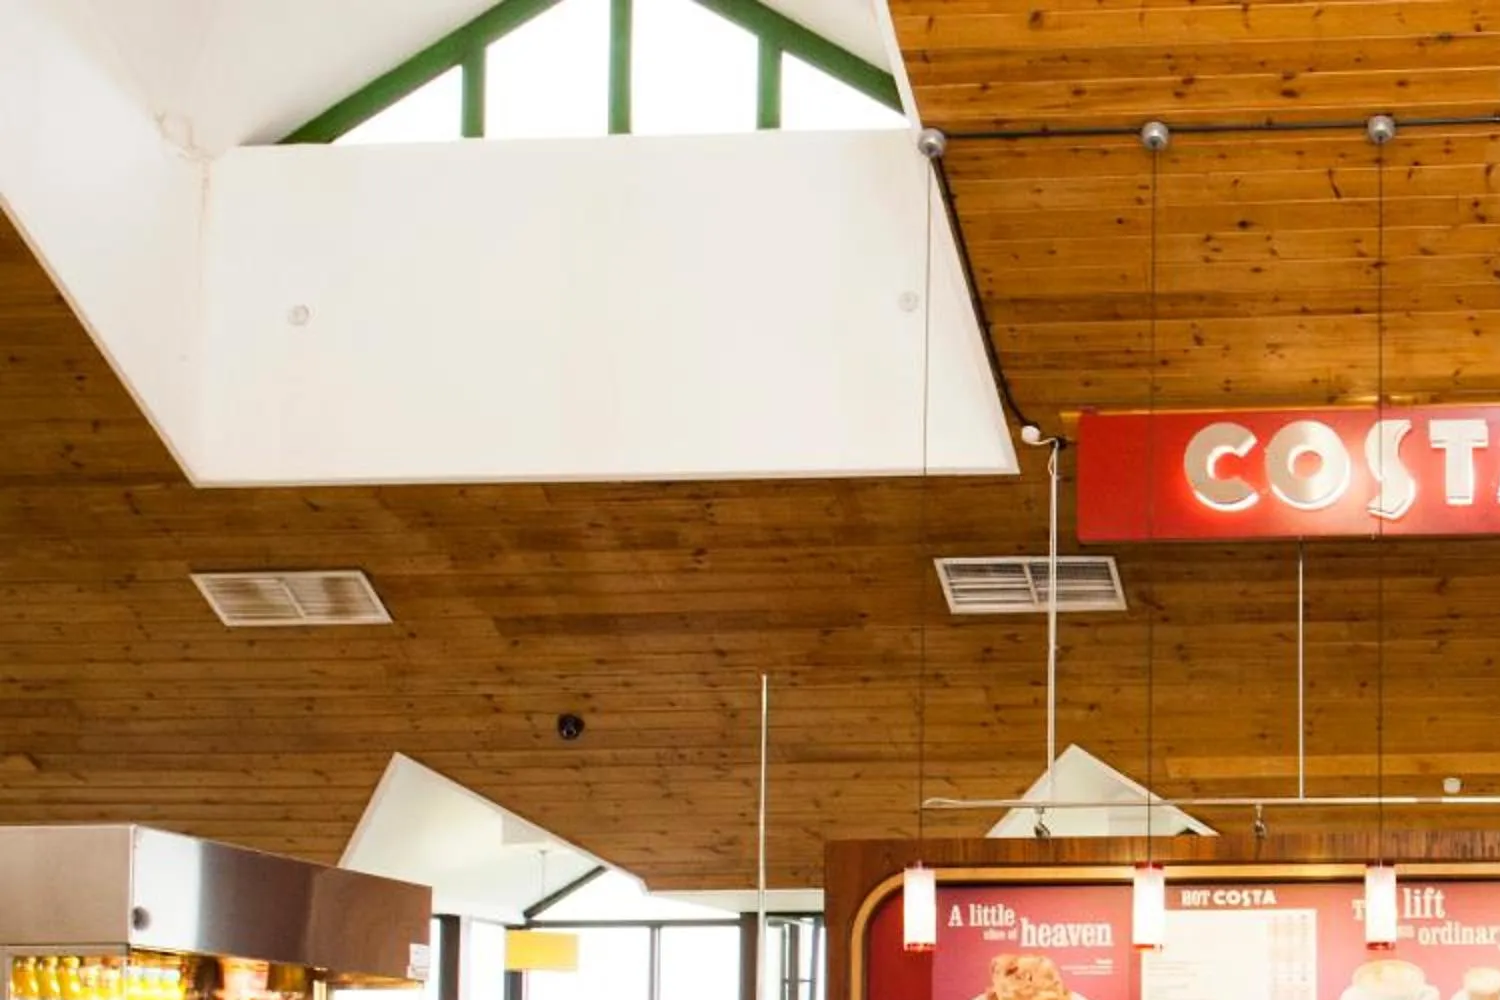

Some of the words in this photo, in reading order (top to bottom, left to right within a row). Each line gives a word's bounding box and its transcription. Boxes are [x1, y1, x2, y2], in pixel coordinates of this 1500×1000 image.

[1181, 889, 1210, 906] HOT
[1213, 888, 1277, 907] COSTA
[1403, 887, 1446, 919] lift
[948, 904, 964, 927] A
[969, 903, 1016, 927] little
[1020, 917, 1114, 947] heaven
